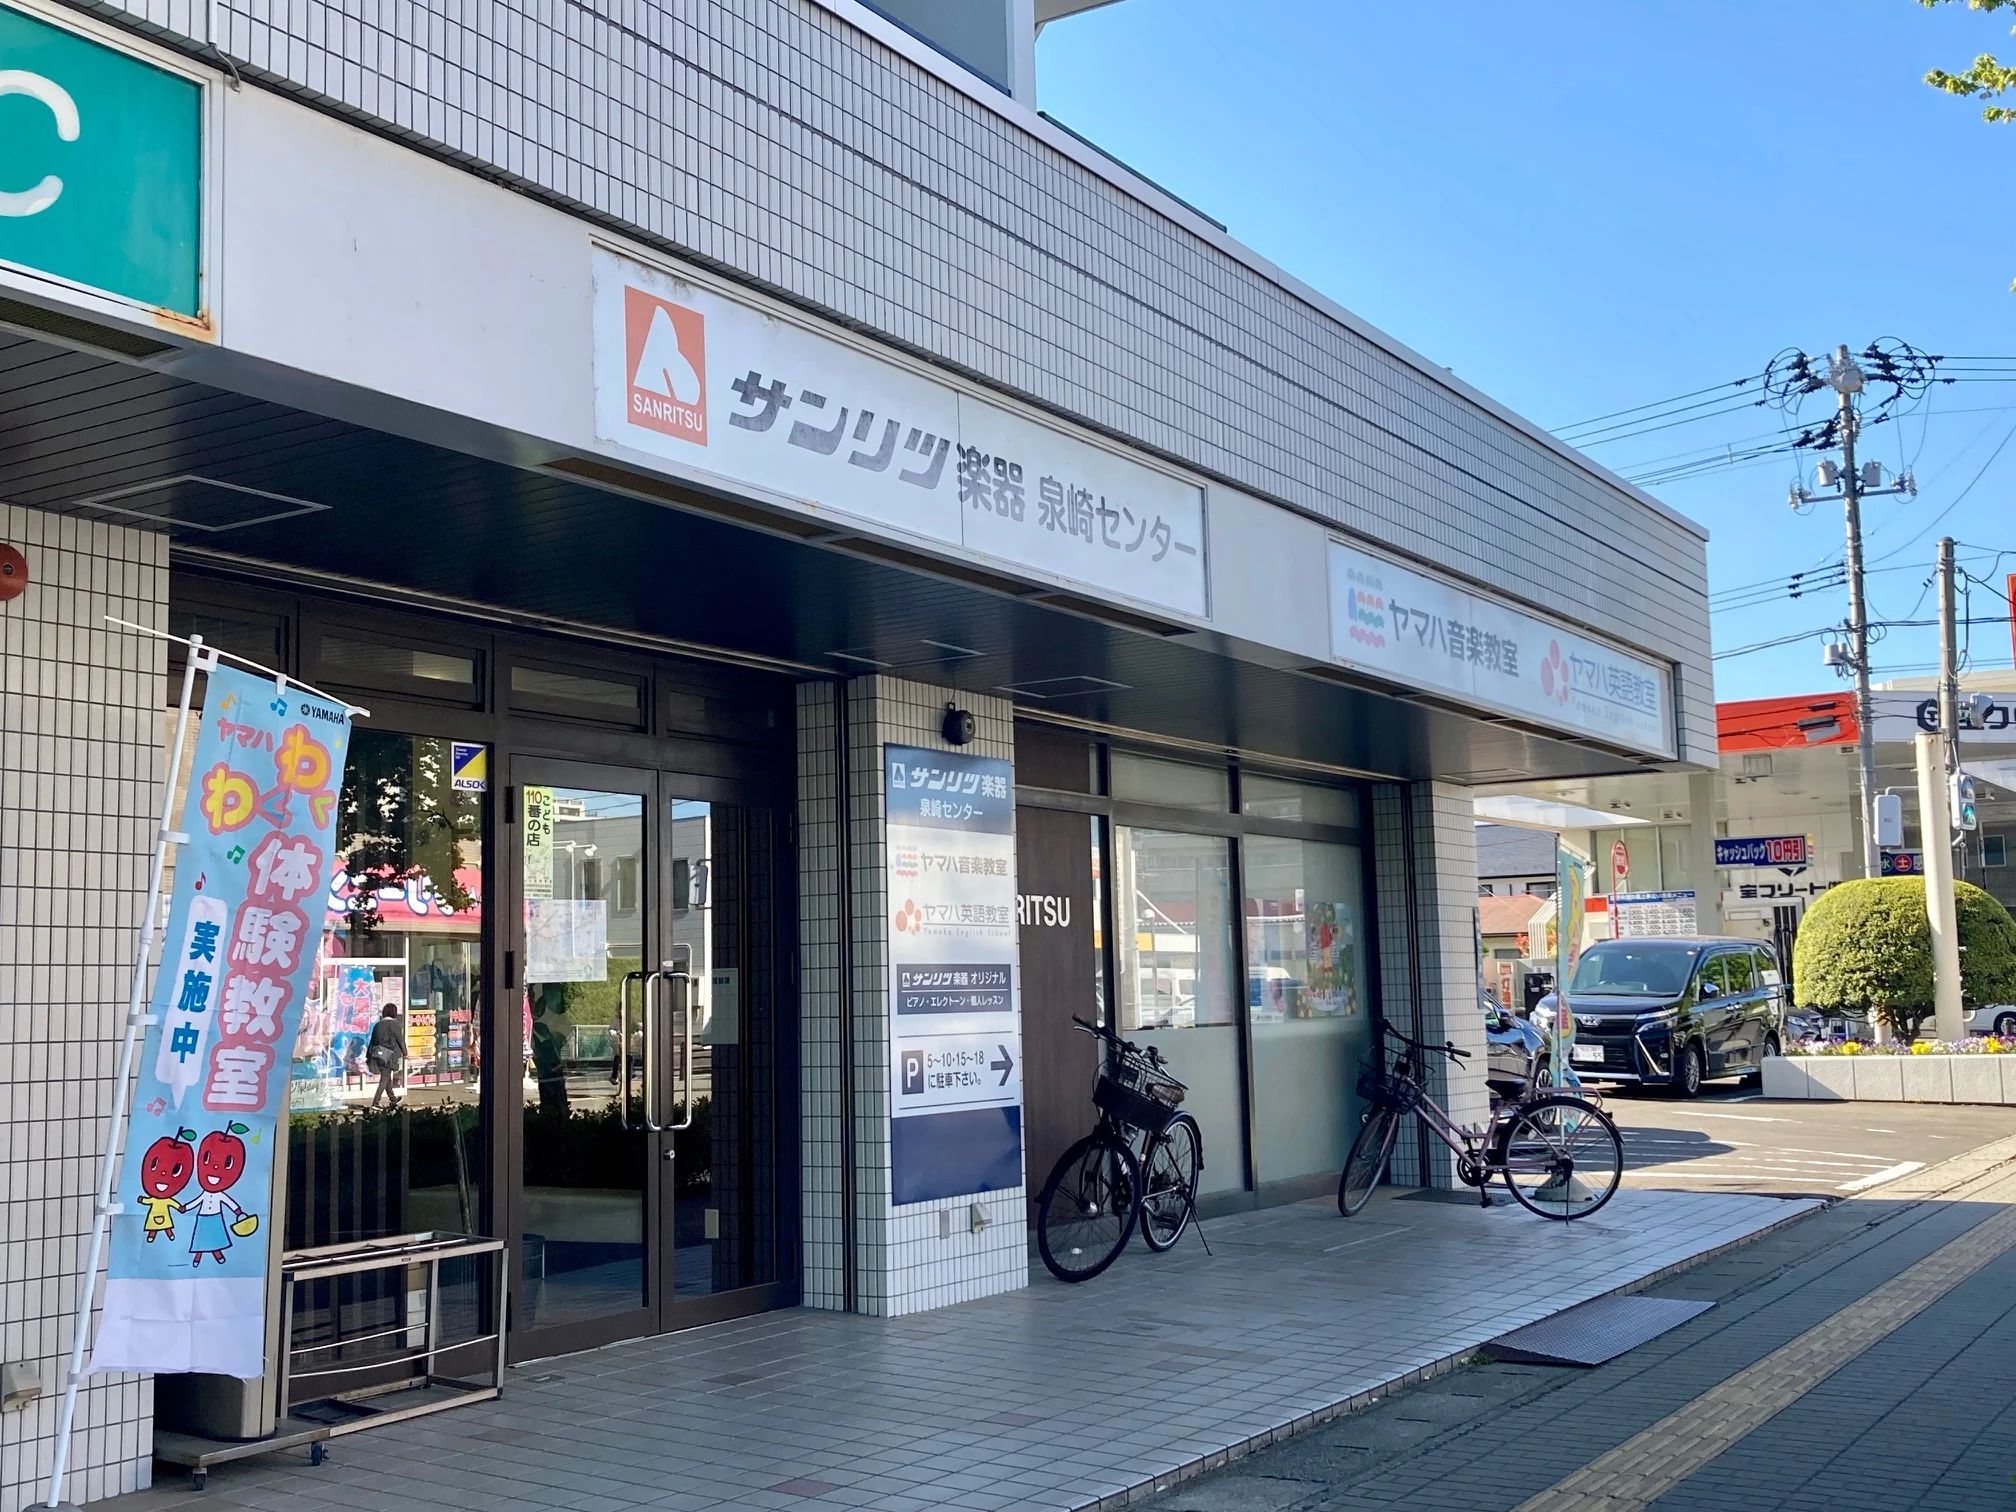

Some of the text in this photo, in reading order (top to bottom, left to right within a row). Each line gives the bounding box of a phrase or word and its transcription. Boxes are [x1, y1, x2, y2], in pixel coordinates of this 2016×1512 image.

[633, 393, 703, 432] SANRITSU
[728, 370, 1197, 562] サンリツ楽器 泉崎センター
[1388, 598, 1520, 678] ヤマハ音楽教室
[1569, 651, 1657, 711] ヤマハ英語教室
[312, 706, 345, 725] YAMAHA
[217, 717, 274, 753] ヤマハ
[910, 767, 1007, 799] サンリツ楽器
[542, 795, 551, 835] こども
[920, 798, 983, 820] 泉崎センター
[921, 853, 1008, 876] ヤマハ音楽教室
[1897, 857, 1909, 869] 土
[923, 903, 1009, 924] ヤマハ英語教室
[204, 833, 321, 1110] 体験教室
[912, 971, 1007, 986] サンリツ楽器 オリジナル
[170, 921, 220, 1064] 実施中
[906, 1058, 919, 1089] P
